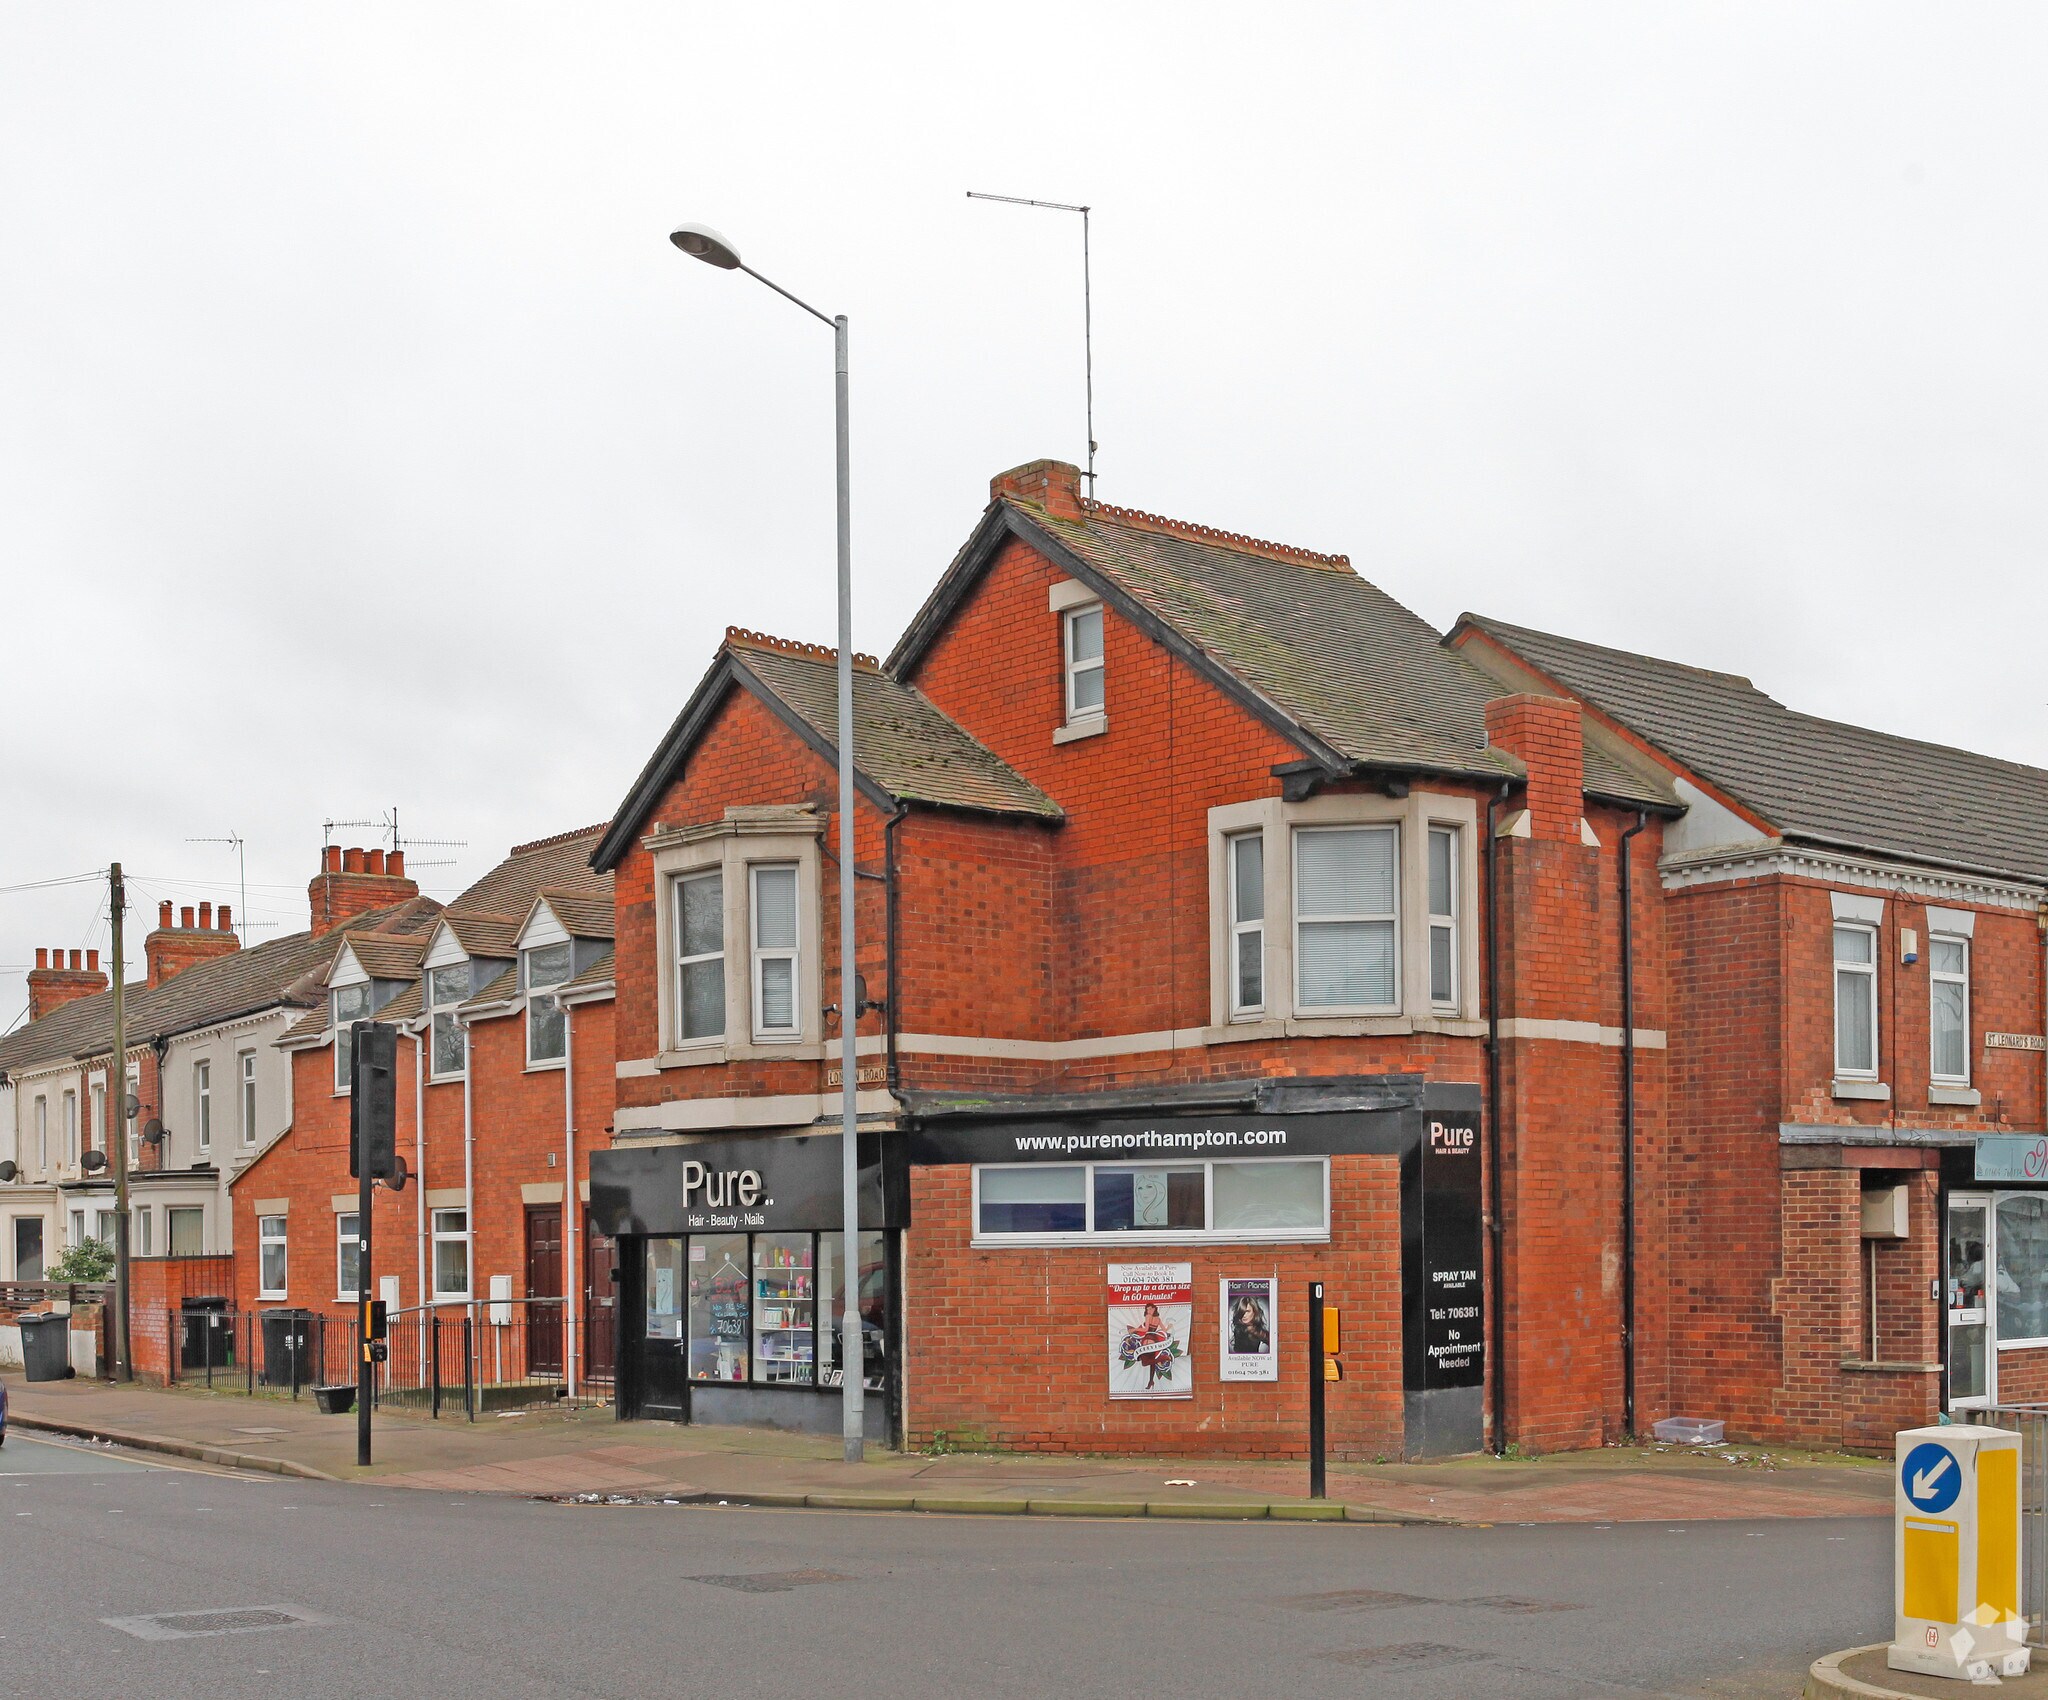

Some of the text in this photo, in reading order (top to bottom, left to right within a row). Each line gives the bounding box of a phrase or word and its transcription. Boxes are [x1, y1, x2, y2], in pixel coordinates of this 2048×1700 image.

[864, 1068, 885, 1081] ROAD
[1430, 1121, 1474, 1146] Pure
[1015, 1130, 1287, 1153] www.purenorthampton.com
[688, 1214, 704, 1226] Hair
[710, 1213, 738, 1228] Beauty
[744, 1212, 765, 1225] Nails
[360, 1239, 367, 1251] 9
[1432, 1270, 1477, 1282] SPRAY TAN
[1132, 1285, 1141, 1293] up
[1158, 1283, 1177, 1291] dress
[1228, 1281, 1269, 1289] Hair Planet
[1131, 1293, 1142, 1301] 60
[1430, 1306, 1479, 1320] Tel: 706381
[717, 1319, 746, 1335] 706381
[1448, 1329, 1461, 1340] No
[1428, 1342, 1481, 1357] Appointment
[1439, 1357, 1470, 1369] Needed
